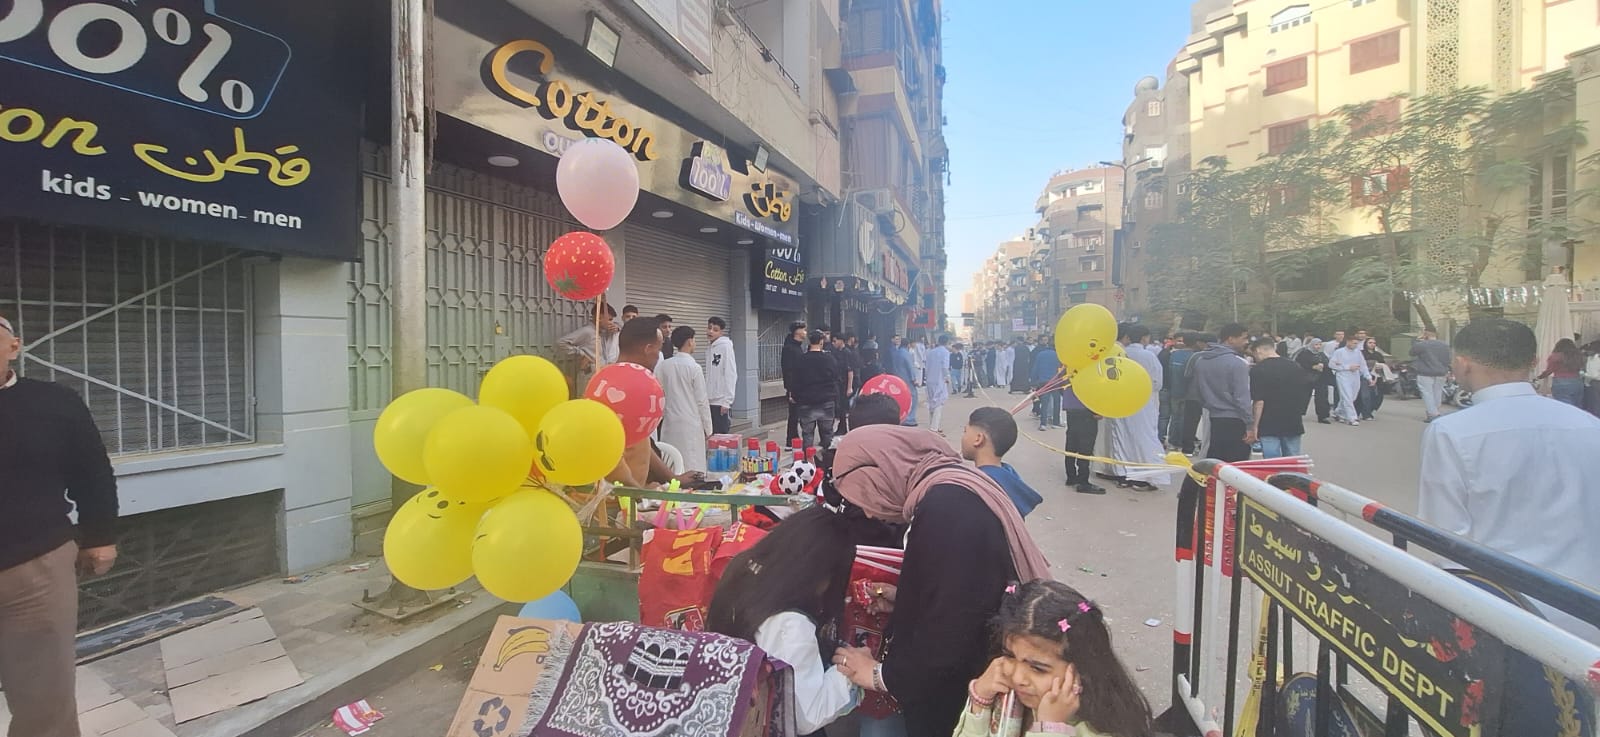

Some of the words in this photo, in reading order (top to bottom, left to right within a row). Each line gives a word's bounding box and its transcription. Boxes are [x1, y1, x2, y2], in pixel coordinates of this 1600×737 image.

[491, 39, 659, 161] Cotton
[0, 108, 107, 155] on
[133, 127, 311, 186] قطن
[42, 170, 112, 201] kids
[253, 207, 302, 229] men
[1248, 549, 1293, 594] ASSIUT
[1296, 583, 1376, 659] TRAFFIC
[1381, 646, 1454, 718] DEPT
